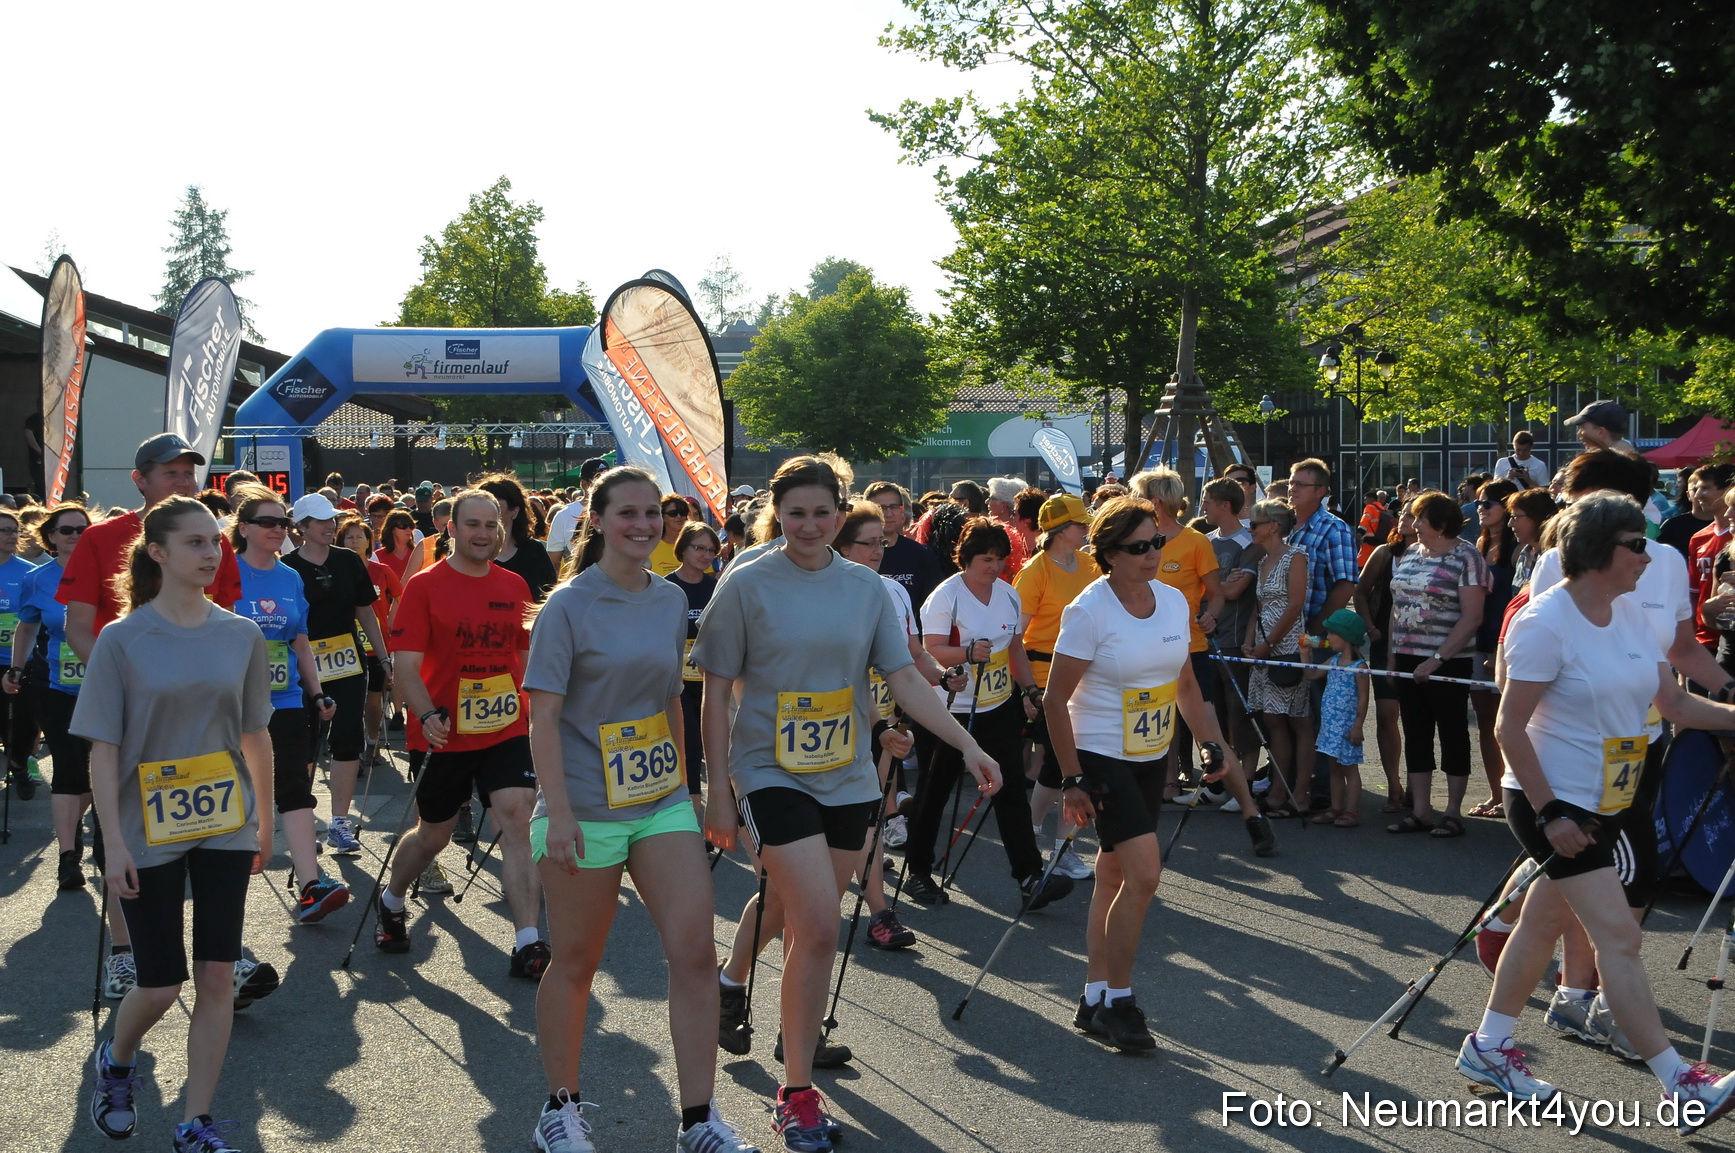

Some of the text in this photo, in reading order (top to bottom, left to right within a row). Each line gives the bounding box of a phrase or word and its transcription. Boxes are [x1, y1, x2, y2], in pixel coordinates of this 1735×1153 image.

[452, 345, 478, 353] Fischer
[188, 305, 225, 428] Fischer
[433, 360, 510, 375] firmenlauf
[285, 385, 328, 395] Fischer
[252, 613, 288, 625] camping
[315, 648, 357, 672] 1103
[461, 664, 487, 673] Alles
[461, 693, 518, 720] 1346
[780, 715, 850, 752] 1371
[1133, 705, 1171, 738] 414
[608, 742, 678, 786] 1369
[147, 780, 235, 824] 1367
